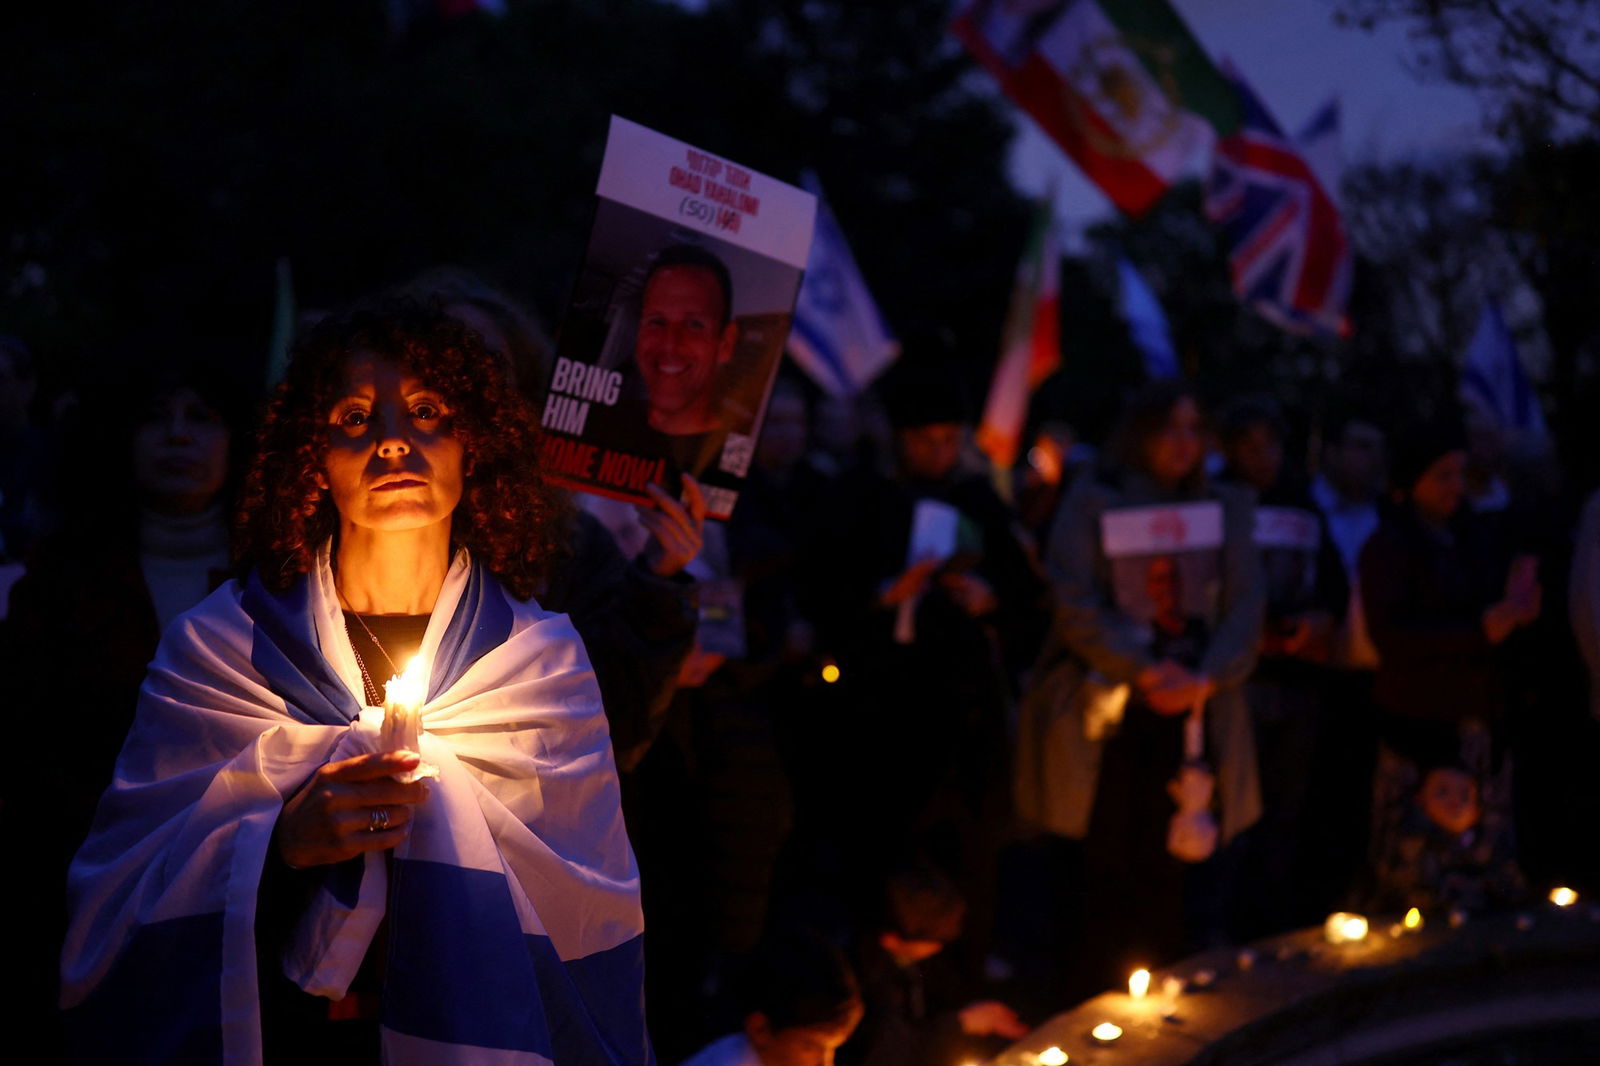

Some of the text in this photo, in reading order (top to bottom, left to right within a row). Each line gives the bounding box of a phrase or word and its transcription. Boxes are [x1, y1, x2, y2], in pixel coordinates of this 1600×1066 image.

[679, 196, 716, 225] (50)
[550, 356, 623, 407] BRING
[541, 392, 591, 437] HIM
[596, 449, 667, 492] NOW!
